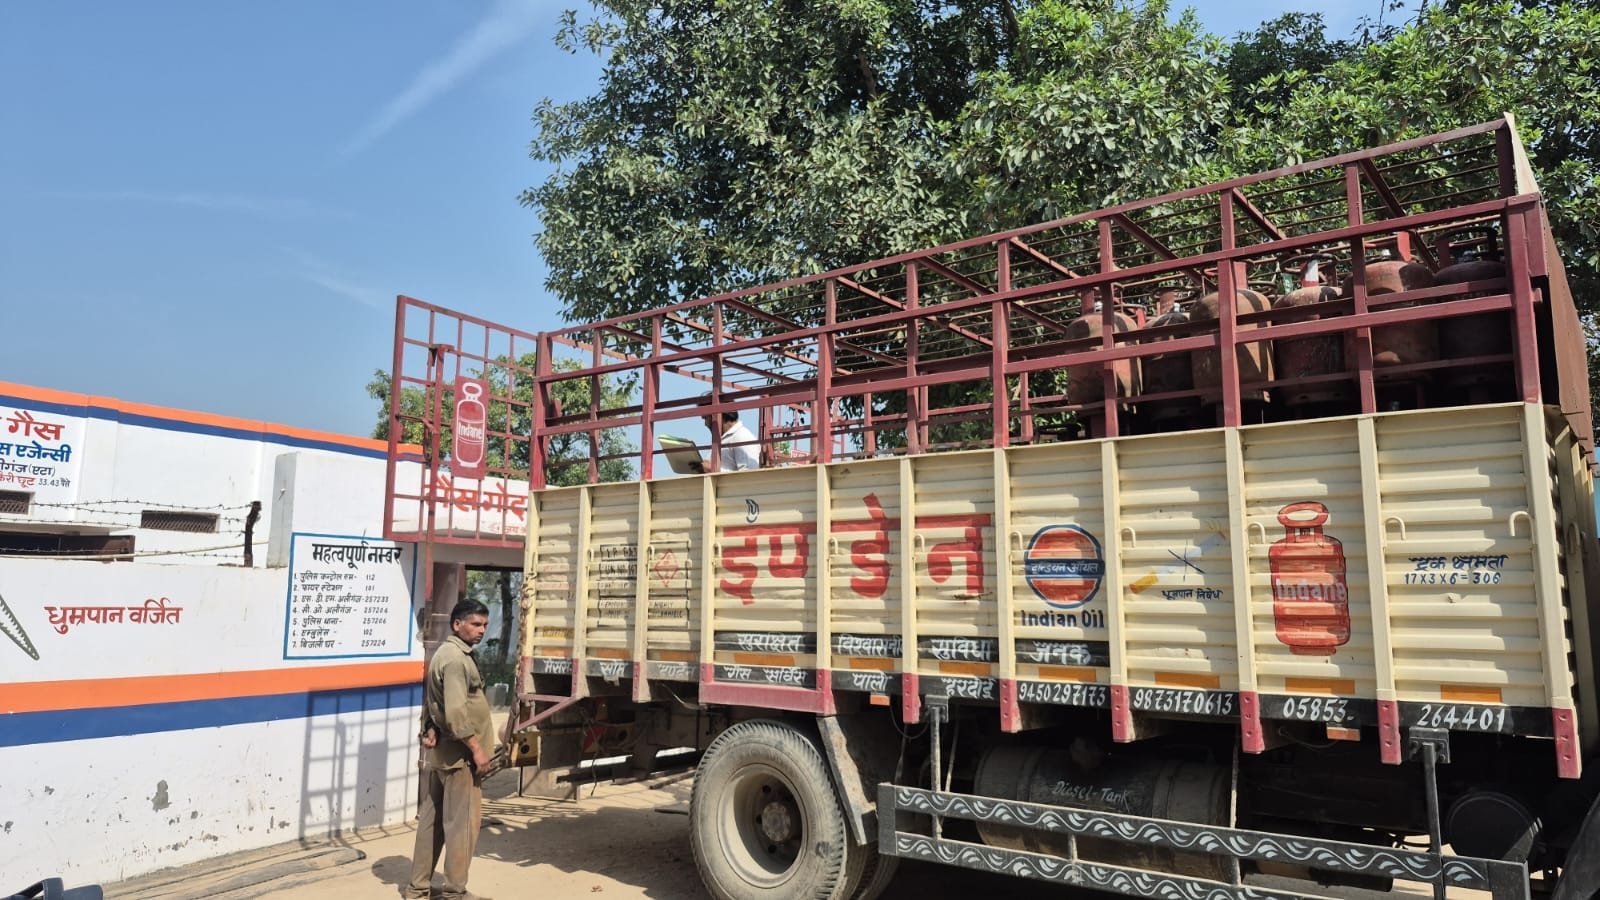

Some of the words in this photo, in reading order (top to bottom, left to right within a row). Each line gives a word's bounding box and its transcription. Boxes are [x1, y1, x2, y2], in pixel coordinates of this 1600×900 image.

[6, 410, 65, 440] गैस
[312, 541, 368, 570] महत्वपूर्ण
[1452, 554, 1509, 570] क्षमता
[300, 570, 318, 583] पुलिस
[127, 597, 183, 625] वर्जित
[301, 615, 322, 628] पुलिस
[1021, 609, 1077, 627] Indian
[1082, 609, 1104, 628] Oil
[1018, 682, 1107, 707] 9450297173
[1133, 688, 1232, 715] 9873170613
[1416, 703, 1505, 732] 264401
